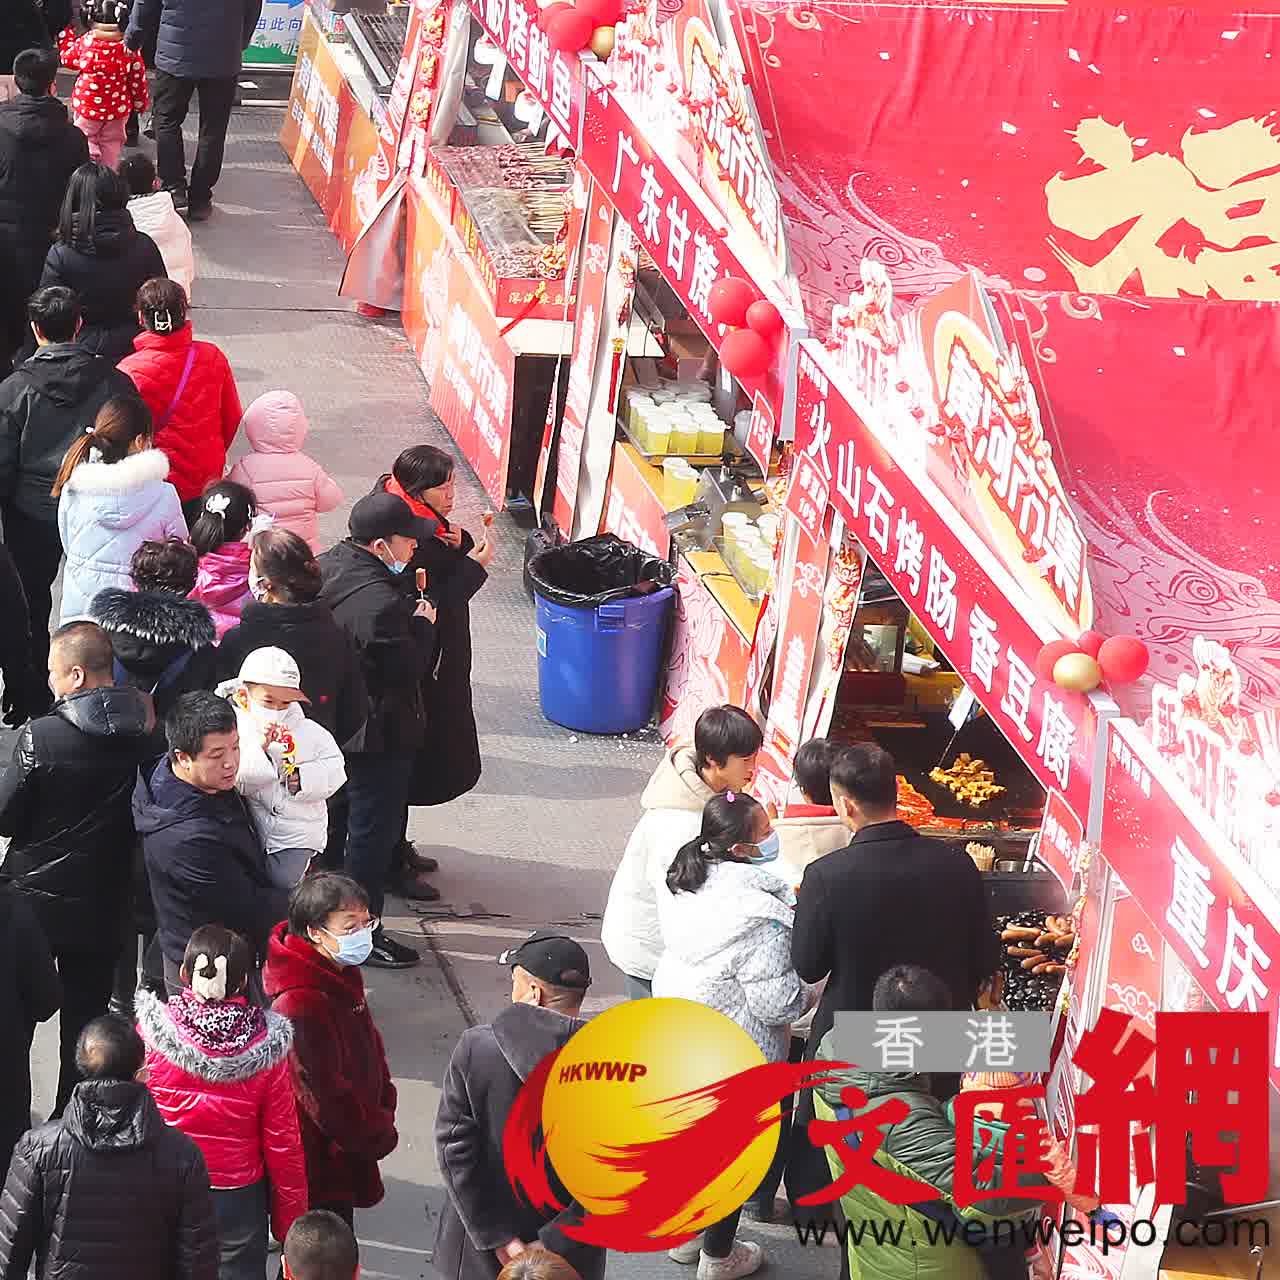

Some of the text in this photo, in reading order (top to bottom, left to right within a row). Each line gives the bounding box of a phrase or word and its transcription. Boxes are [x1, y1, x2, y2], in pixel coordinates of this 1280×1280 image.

[611, 130, 729, 334] 广东甘蔗
[807, 401, 1079, 790] 火山石烤肠 香豆腐
[1165, 834, 1273, 1012] 重庆
